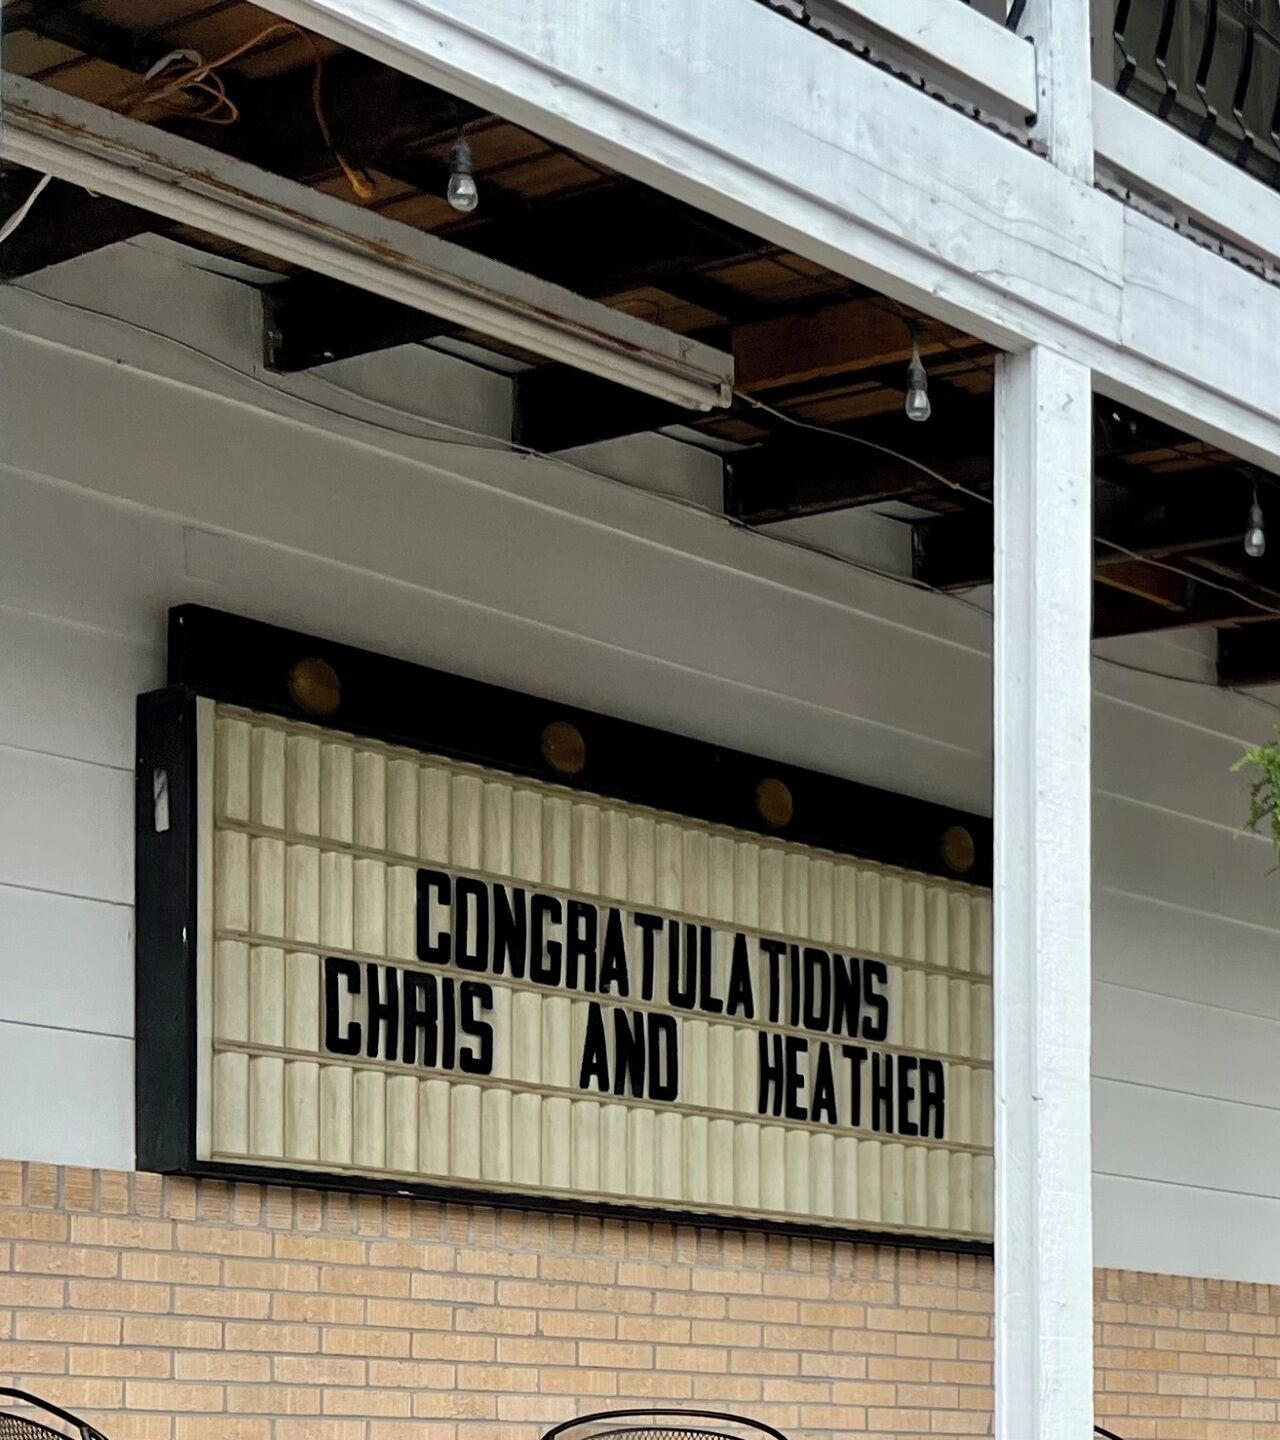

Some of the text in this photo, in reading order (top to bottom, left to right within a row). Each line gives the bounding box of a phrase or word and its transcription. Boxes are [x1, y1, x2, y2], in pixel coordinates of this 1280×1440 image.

[416, 868, 890, 1042] CONGRATULATIONS
[325, 957, 946, 1140] CHRIS AND HEATHER
